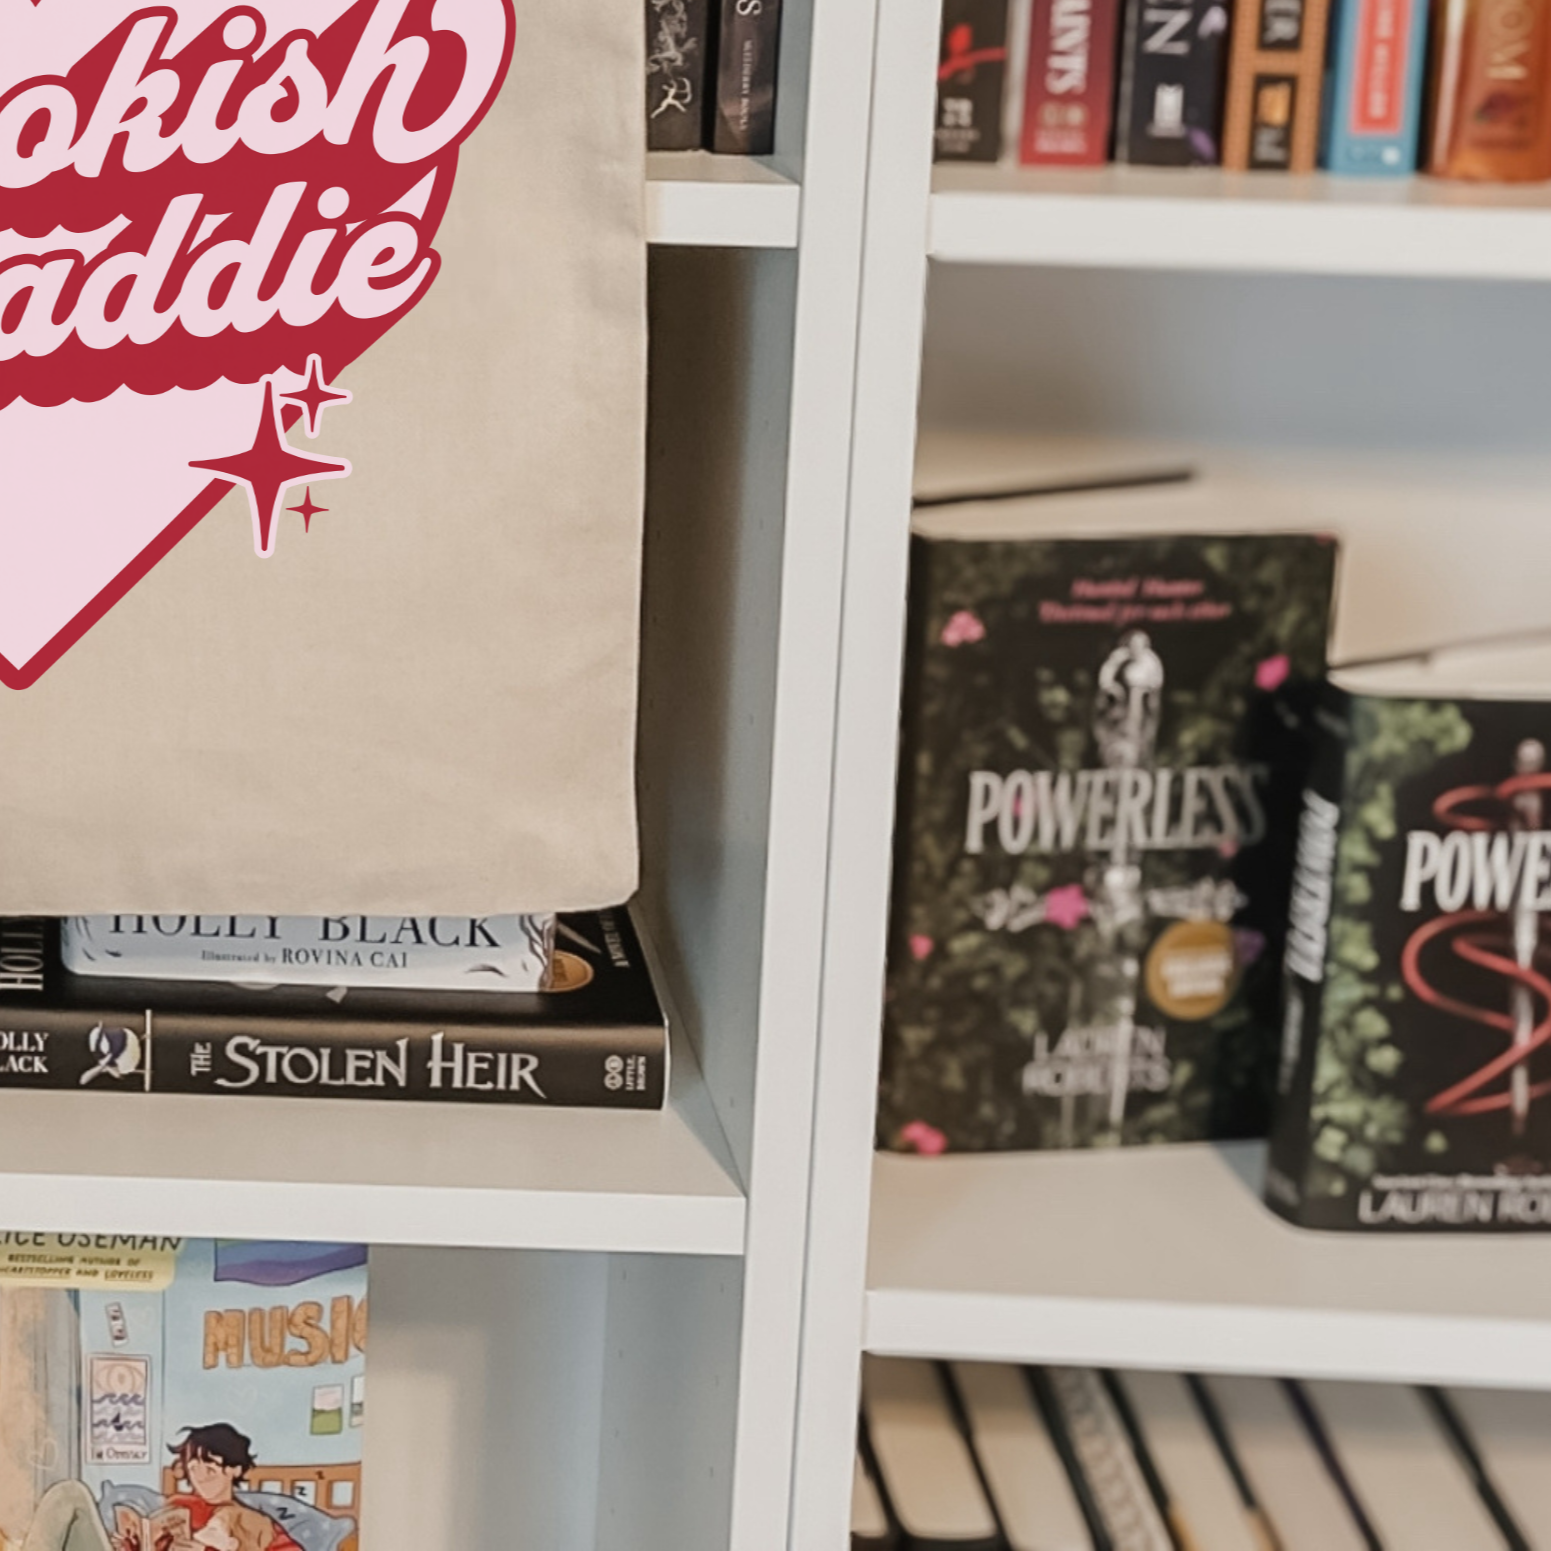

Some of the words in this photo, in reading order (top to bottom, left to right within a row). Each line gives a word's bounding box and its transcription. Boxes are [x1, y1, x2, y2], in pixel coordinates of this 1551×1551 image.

[965, 764, 1267, 854] POWERLESS
[108, 915, 283, 939] HOLLY
[318, 916, 503, 948] BLACK
[282, 948, 362, 968] ROVINA
[370, 951, 408, 969] CAI
[189, 1042, 213, 1077] THE
[214, 1035, 410, 1090] STOLEN
[426, 1031, 548, 1099] HEIR
[57, 1232, 183, 1253] OSEMAN
